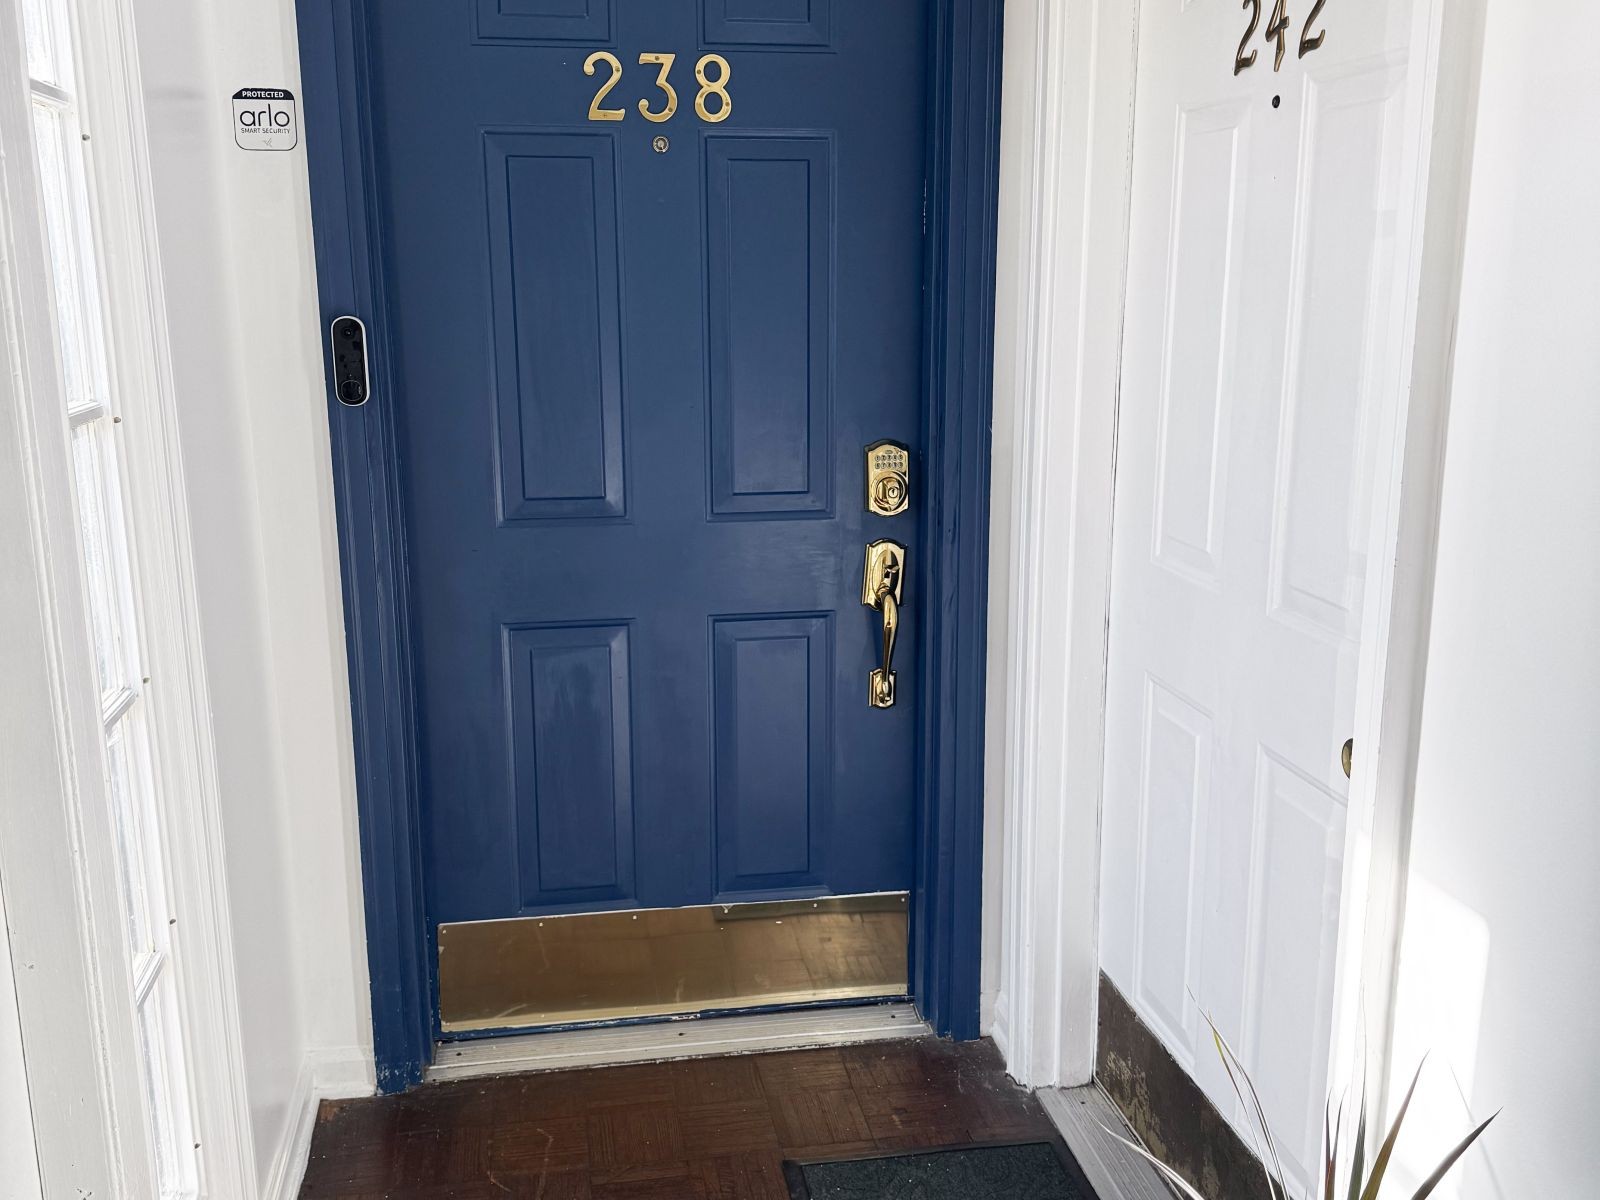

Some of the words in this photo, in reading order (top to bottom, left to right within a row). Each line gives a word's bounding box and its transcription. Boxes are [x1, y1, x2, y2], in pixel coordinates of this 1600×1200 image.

[1233, 0, 1327, 76] 242
[240, 103, 290, 127] arlo
[583, 51, 732, 123] 238
